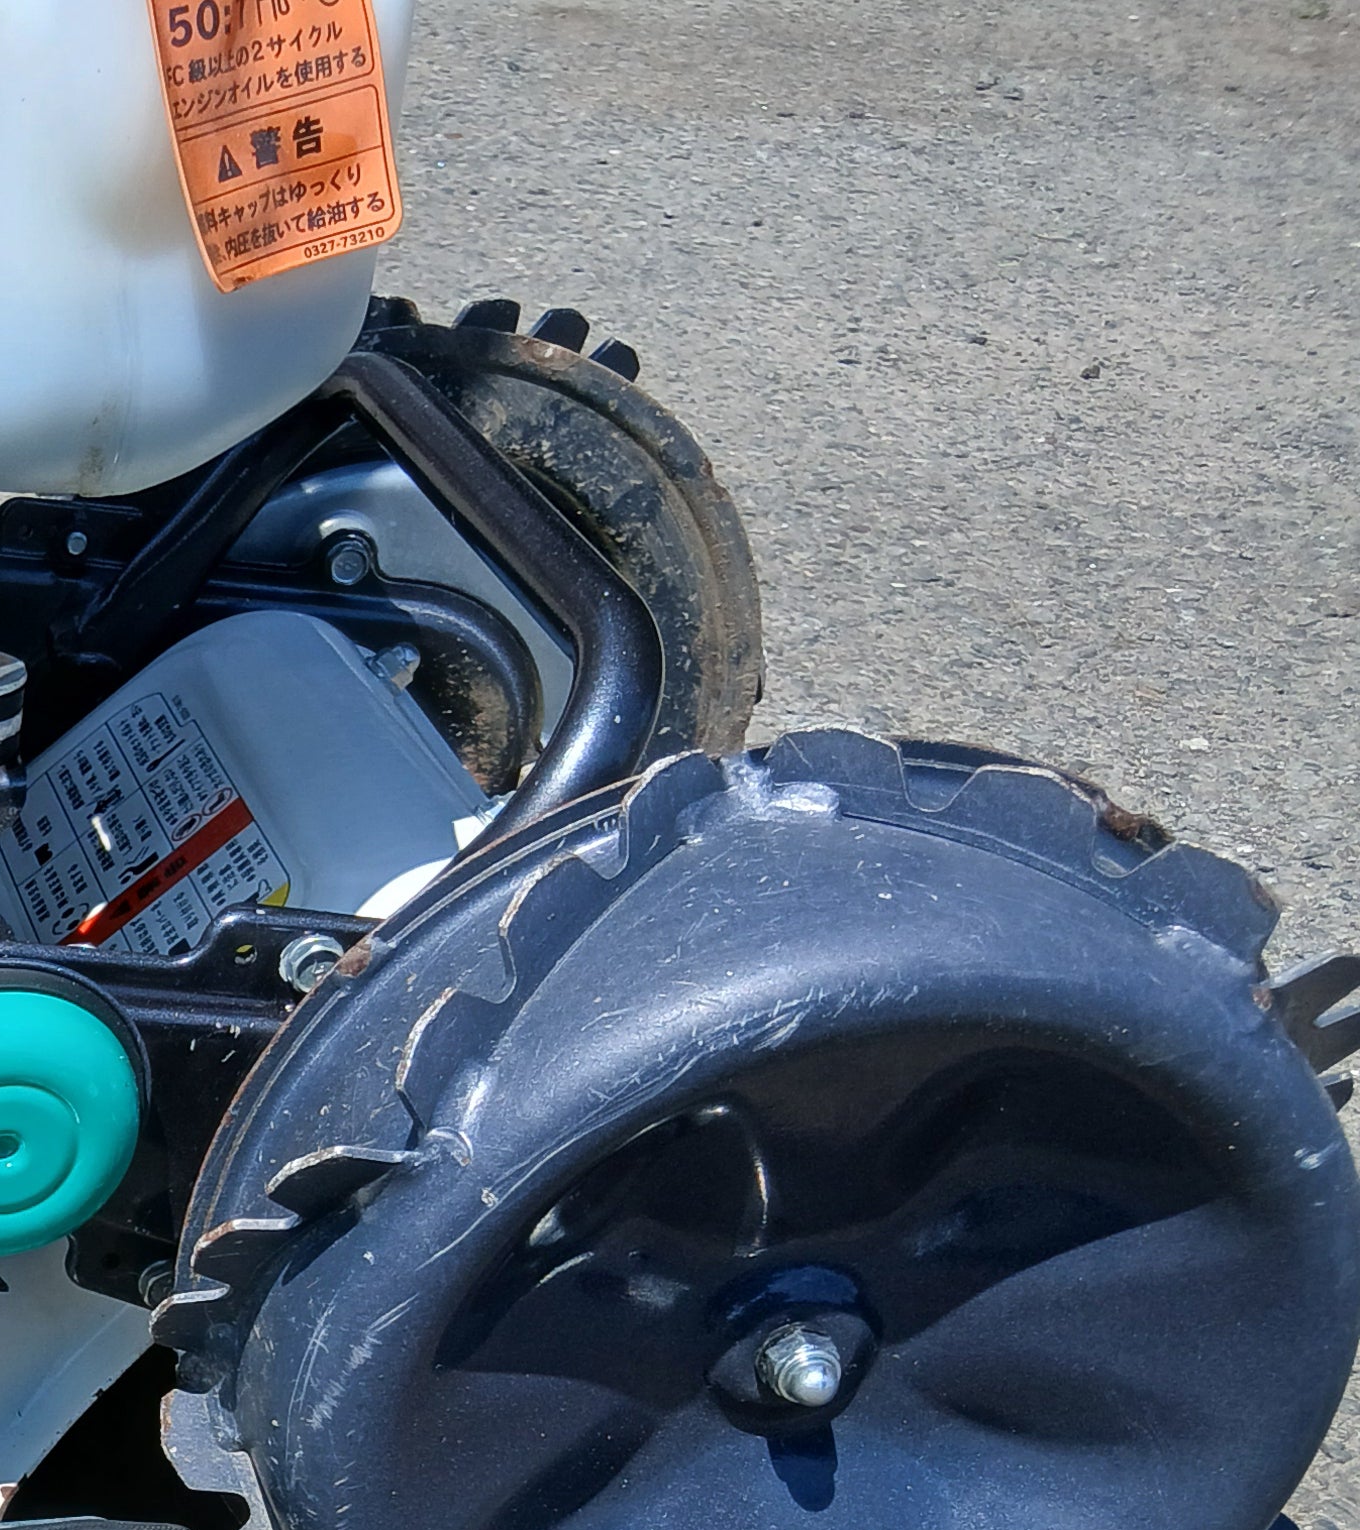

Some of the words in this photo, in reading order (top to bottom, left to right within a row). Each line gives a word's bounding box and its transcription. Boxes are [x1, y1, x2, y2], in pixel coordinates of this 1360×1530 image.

[173, 46, 367, 119] エンジンオイルを使用する
[249, 115, 324, 170] 警告
[303, 226, 385, 259] 0327-73210
